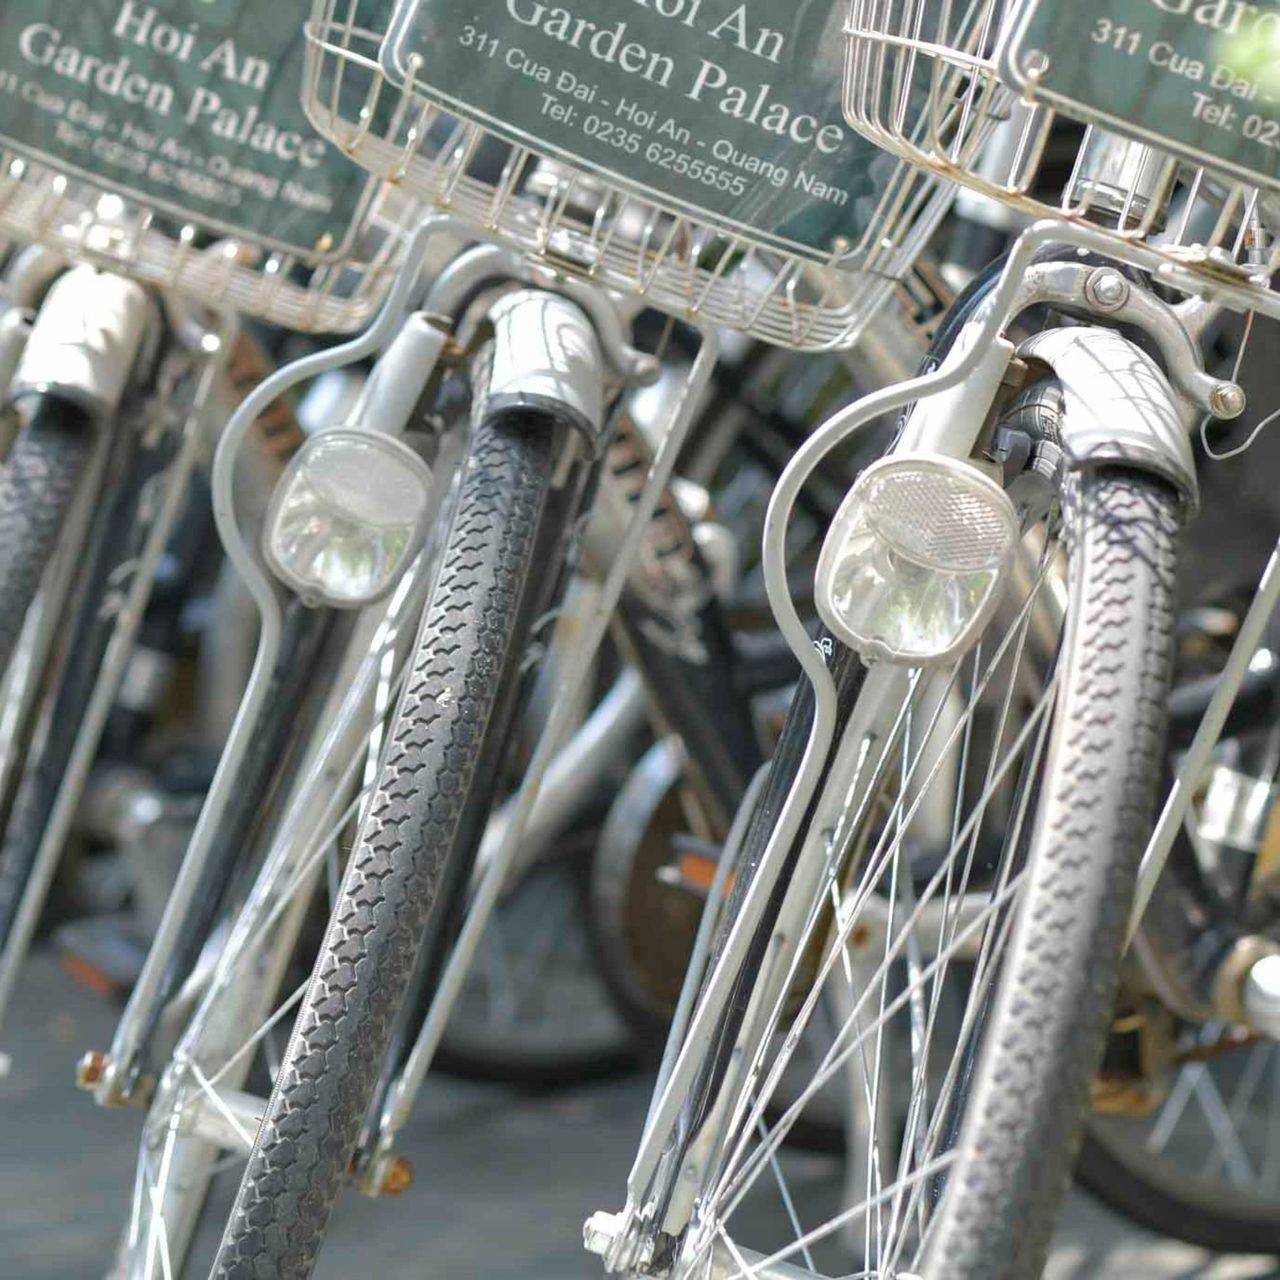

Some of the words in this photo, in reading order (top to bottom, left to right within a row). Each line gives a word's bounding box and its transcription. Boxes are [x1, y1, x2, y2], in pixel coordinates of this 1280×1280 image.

[200, 38, 271, 90] An
[708, 3, 786, 64] An
[1090, 19, 1141, 55] 311
[1148, 41, 1204, 82] Cua
[20, 23, 175, 116] Garden
[186, 85, 326, 169] Palace
[458, 25, 500, 59] 311
[505, 48, 550, 84] Cua
[555, 72, 600, 104] Đai
[616, 98, 655, 130] Hoi
[657, 117, 692, 146] An
[711, 139, 789, 186] Quang
[794, 171, 849, 206] Nam
[685, 59, 844, 154] Palace
[1190, 92, 1232, 132] Tel:
[540, 93, 578, 127] Tel:
[583, 116, 641, 154] 0235
[645, 143, 748, 197] 6255555
